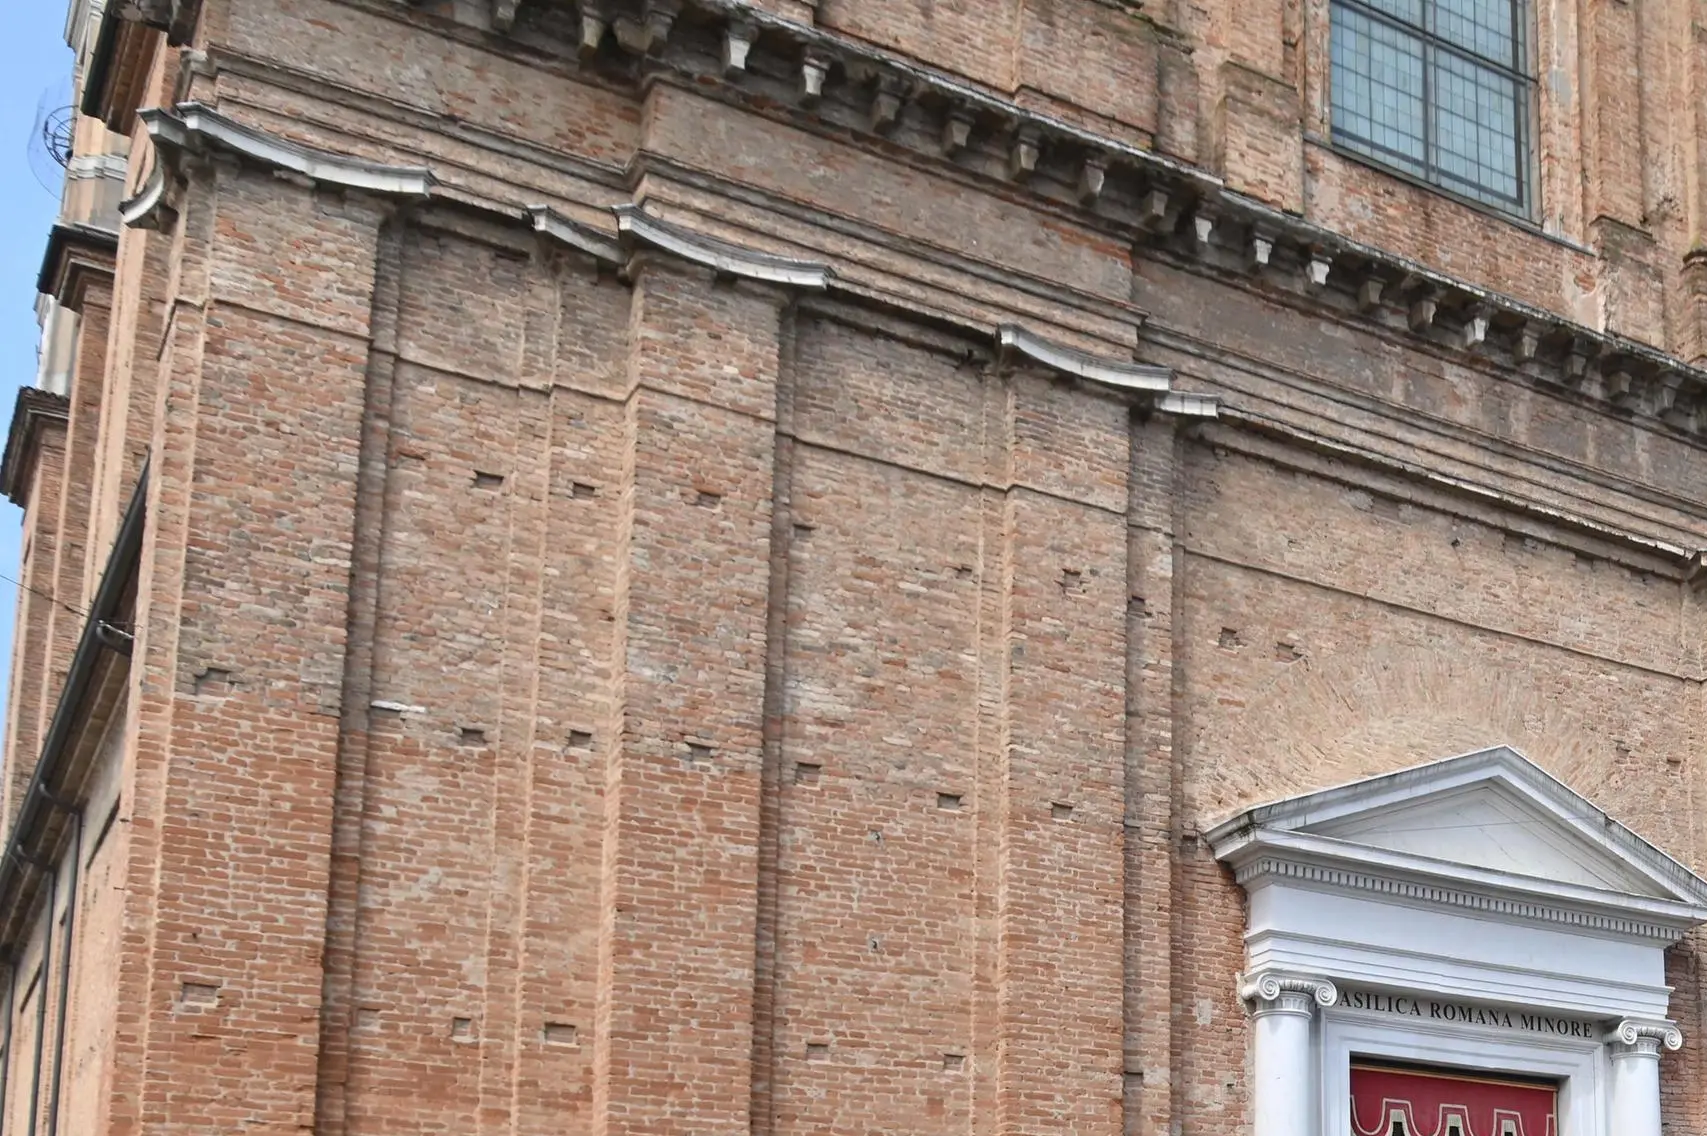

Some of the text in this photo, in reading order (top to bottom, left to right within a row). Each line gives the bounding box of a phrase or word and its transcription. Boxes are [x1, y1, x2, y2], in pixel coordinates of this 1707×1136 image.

[1339, 990, 1593, 1038] ASILICA ROMANA MINORE
